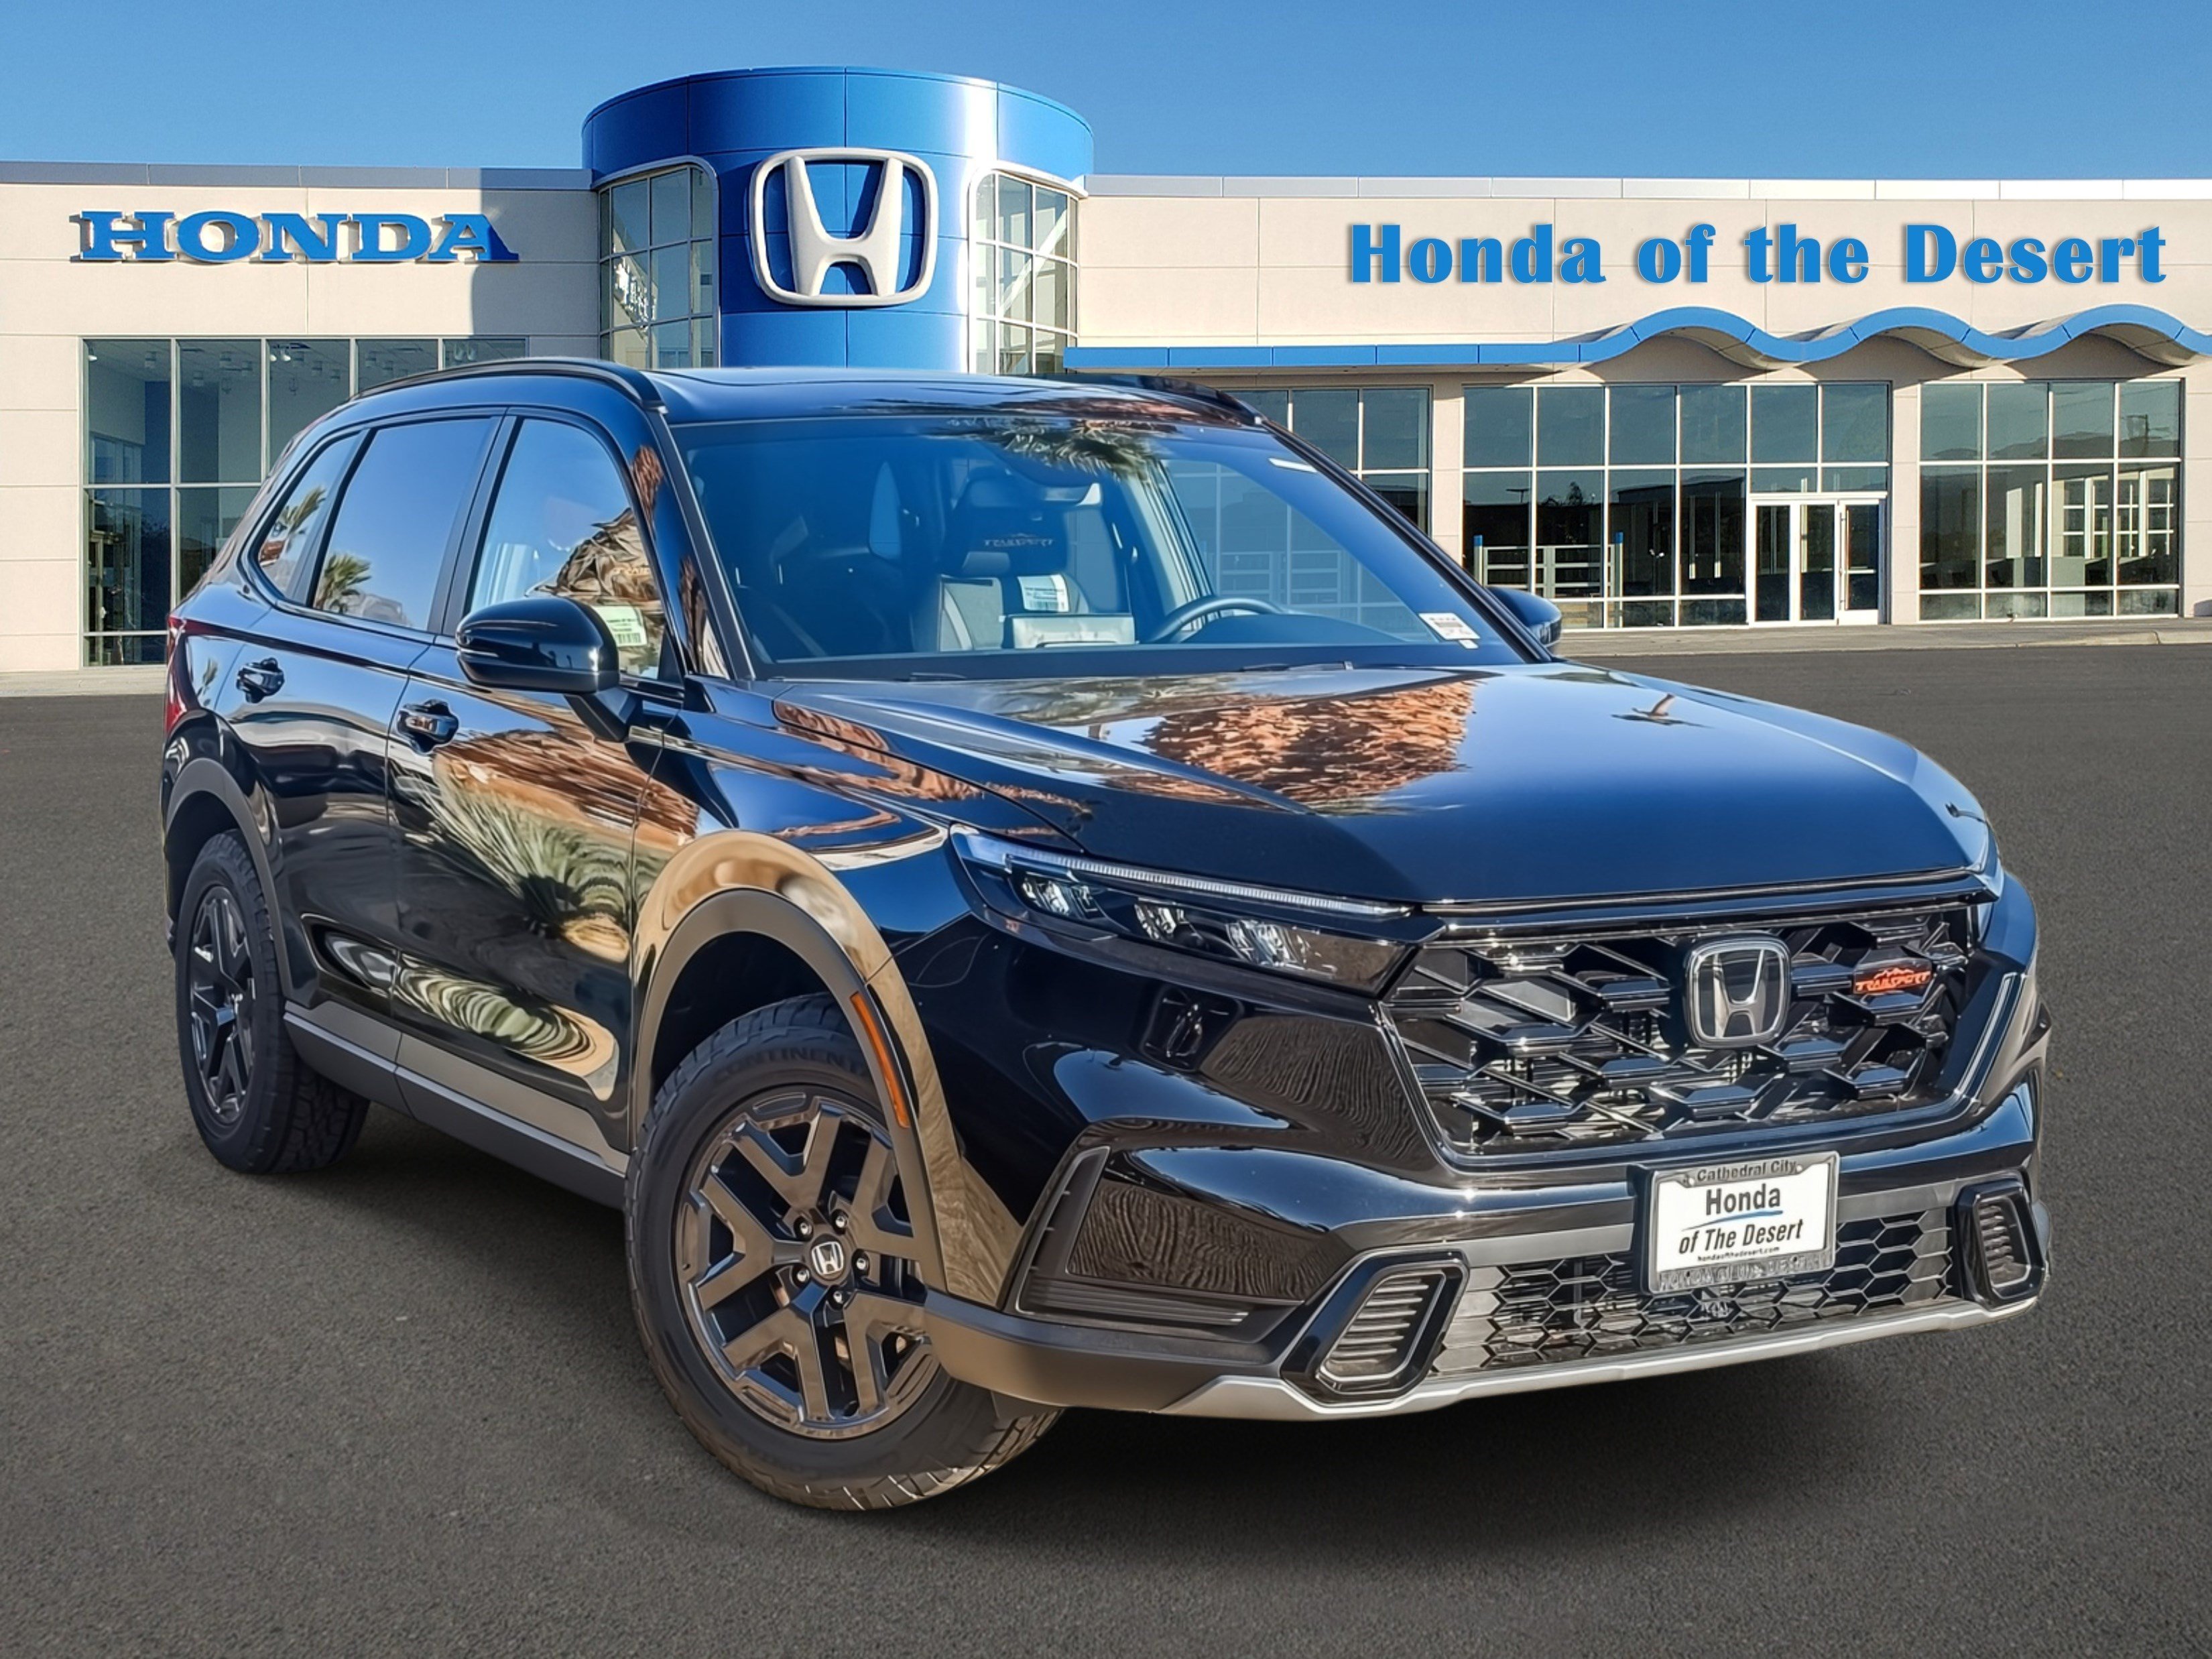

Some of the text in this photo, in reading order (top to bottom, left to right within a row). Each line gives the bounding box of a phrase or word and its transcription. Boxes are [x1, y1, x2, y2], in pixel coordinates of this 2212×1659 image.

[79, 210, 520, 262] HONDA
[1351, 224, 2166, 284] Honda of the Desert
[1697, 1160, 1797, 1182] Cathedral City
[1705, 1183, 1781, 1215] Honda
[1678, 1219, 1803, 1254] of The Desert
